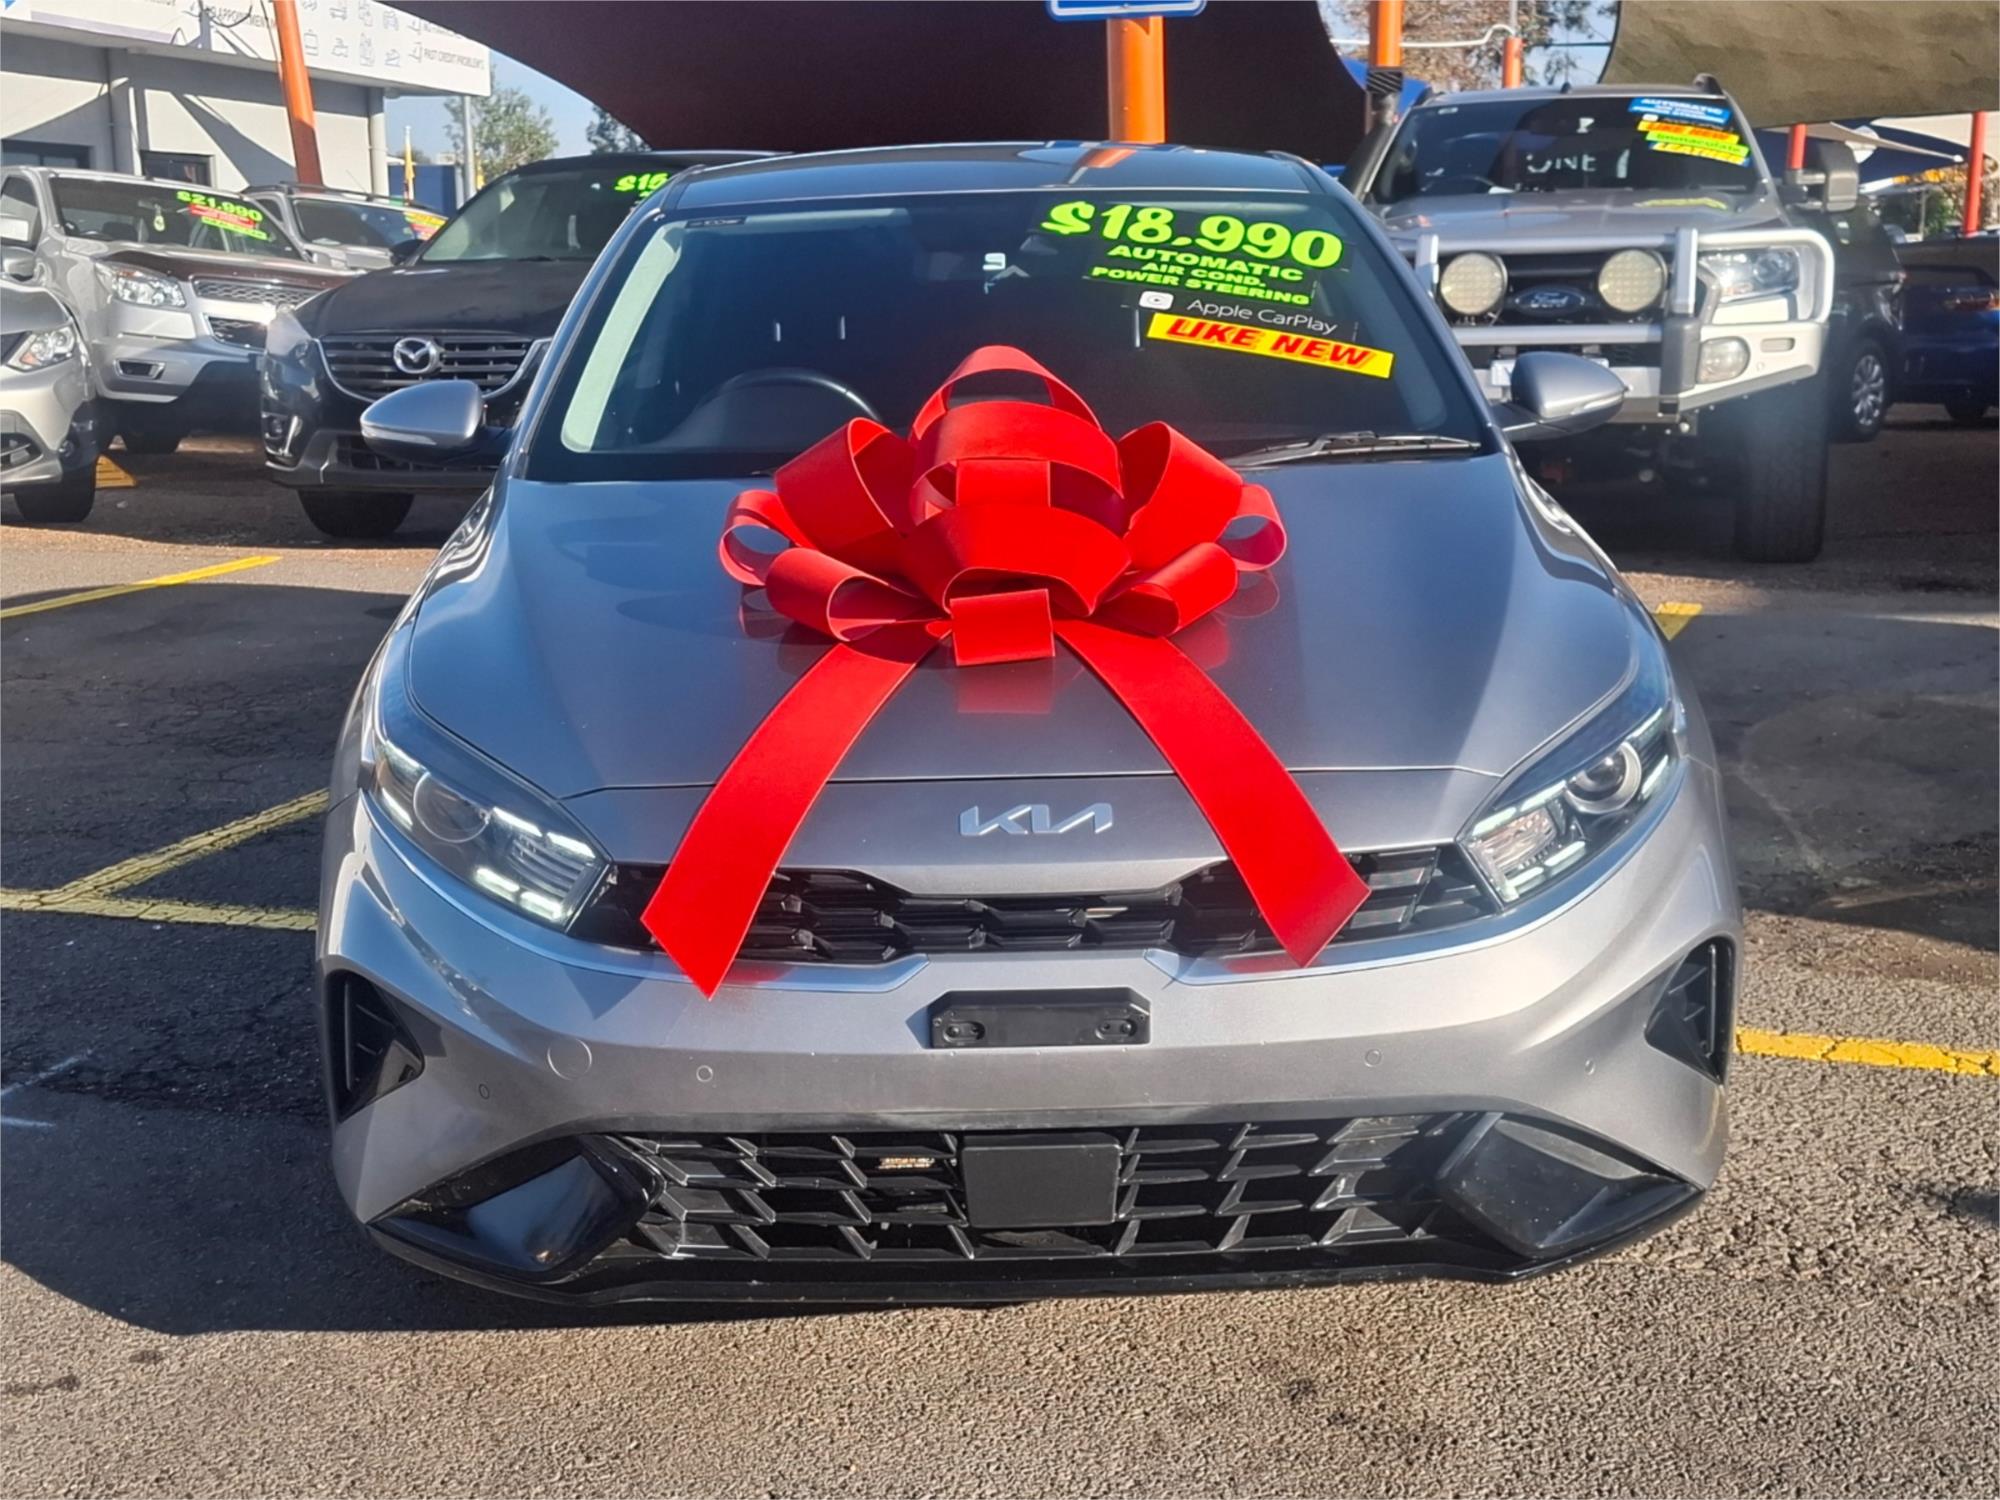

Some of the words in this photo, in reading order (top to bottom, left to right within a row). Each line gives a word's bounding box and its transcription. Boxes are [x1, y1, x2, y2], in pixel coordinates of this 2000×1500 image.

[1107, 244, 1304, 282] AUTOMATIC
[1141, 261, 1186, 276] AIR
[1190, 268, 1267, 288] COND.
[1091, 266, 1180, 287] POWER
[1184, 278, 1310, 305] STEERING
[1187, 299, 1253, 321] Apple
[1257, 309, 1338, 336] CarPlay
[1166, 317, 1263, 349] LIKE
[1270, 334, 1376, 369] NEW
